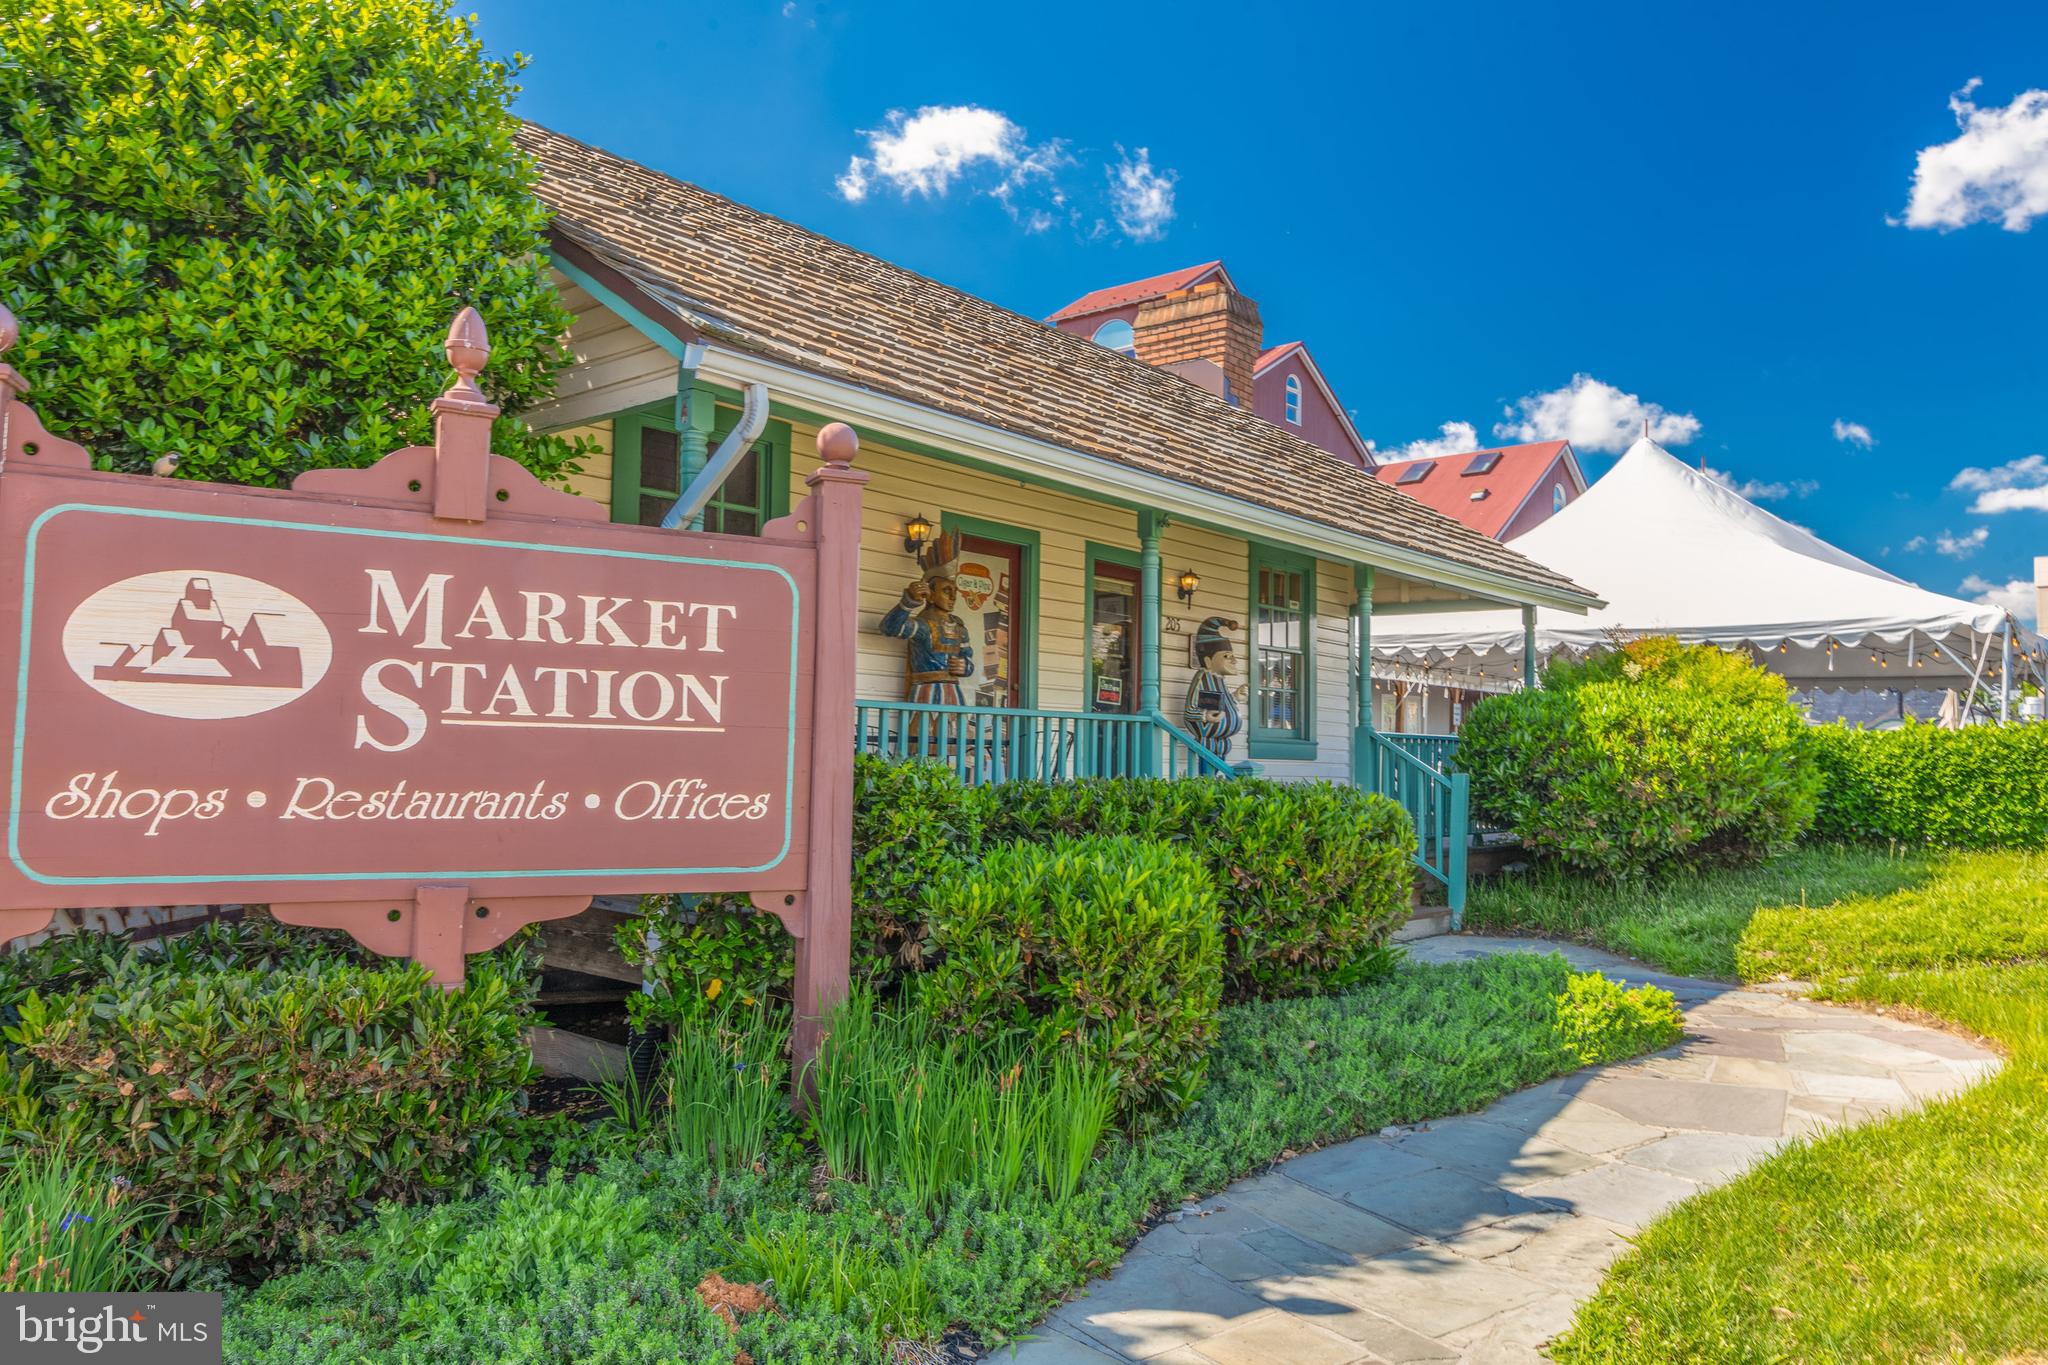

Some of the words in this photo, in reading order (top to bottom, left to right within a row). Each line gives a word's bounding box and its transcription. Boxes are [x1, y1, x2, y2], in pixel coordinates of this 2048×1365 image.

[357, 568, 738, 653] MARKET
[1165, 616, 1181, 632] 205
[353, 658, 730, 753] STATION
[45, 770, 229, 837] Shops
[278, 776, 570, 822] Restaurants
[614, 777, 771, 822] Offices
